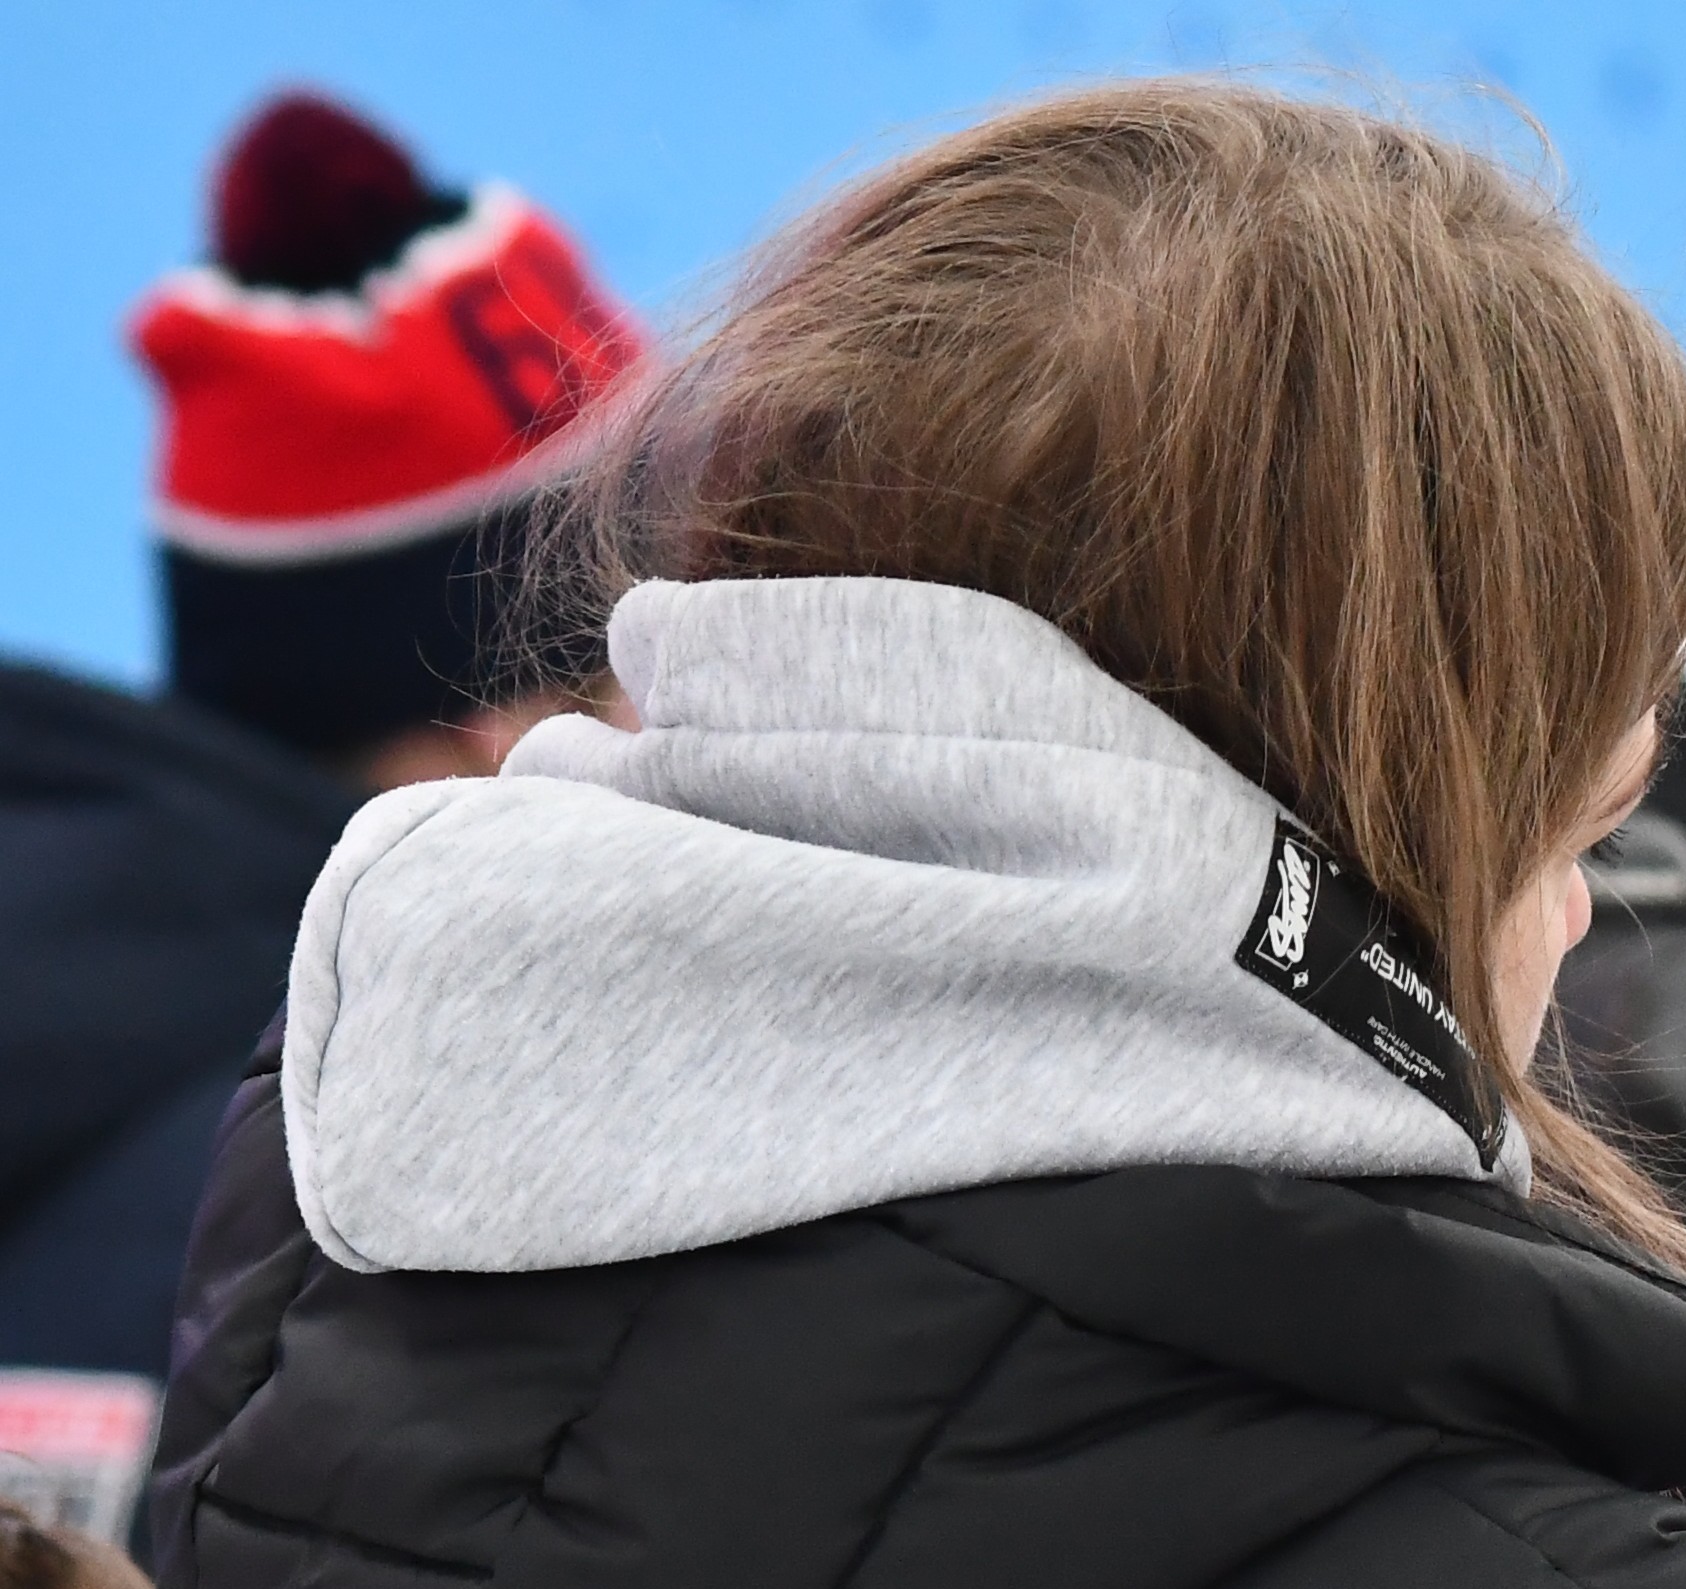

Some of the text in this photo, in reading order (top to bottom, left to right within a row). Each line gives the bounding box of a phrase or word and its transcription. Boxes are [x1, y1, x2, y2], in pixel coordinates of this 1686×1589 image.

[1366, 1015, 1446, 1080] HANDLE WITH CARE
